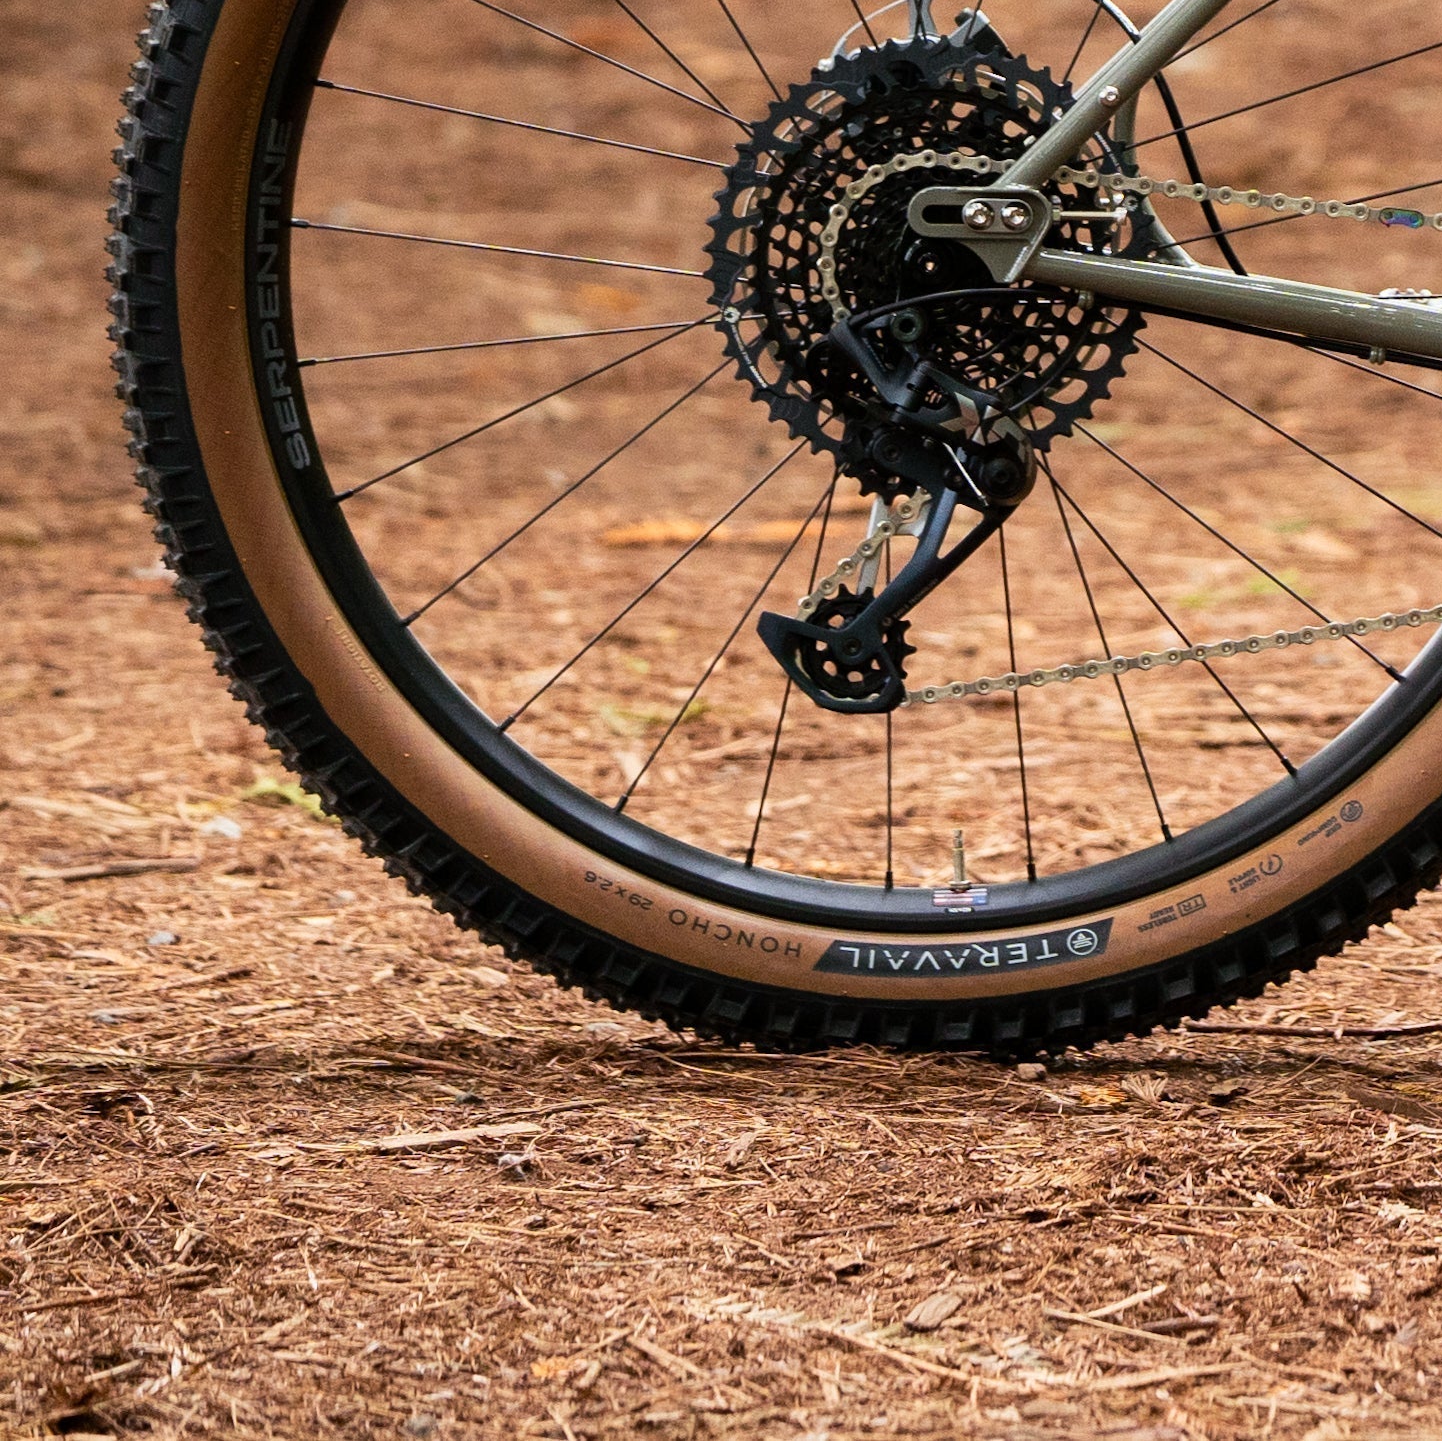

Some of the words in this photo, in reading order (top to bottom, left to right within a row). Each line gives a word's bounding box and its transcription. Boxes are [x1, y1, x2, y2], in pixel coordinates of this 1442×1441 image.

[256, 118, 311, 470] SERPENTINE
[667, 908, 803, 959] HONCHO
[839, 939, 1059, 971] TERAVAIL
